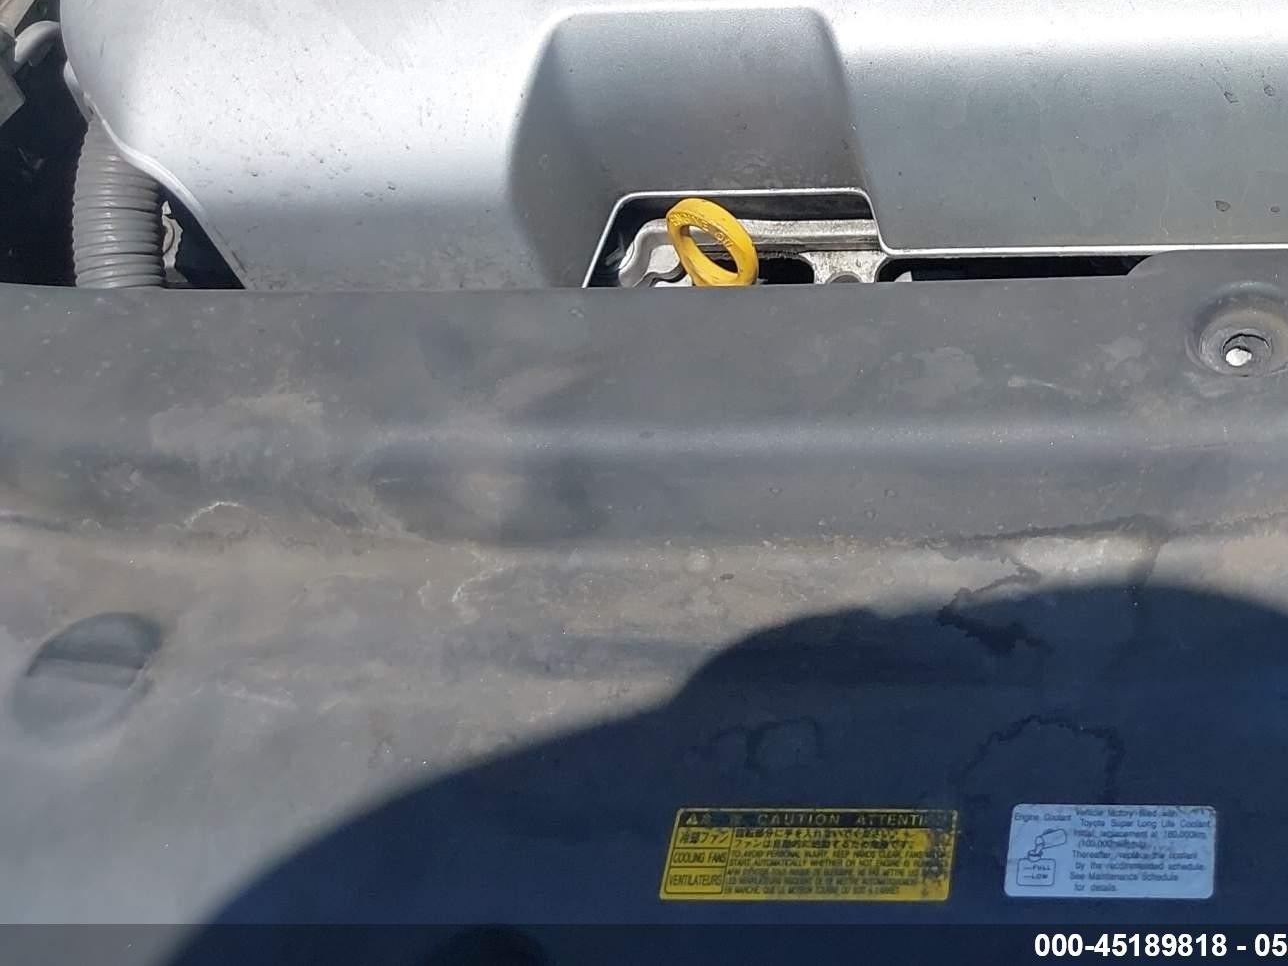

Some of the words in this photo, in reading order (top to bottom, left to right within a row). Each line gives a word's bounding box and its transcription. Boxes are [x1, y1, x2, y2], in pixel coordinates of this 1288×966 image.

[758, 813, 841, 826] CAUTION
[1136, 819, 1157, 830] Long
[672, 851, 706, 863] COOLING
[707, 851, 728, 864] FANS
[670, 874, 722, 886] VENTILATEURS
